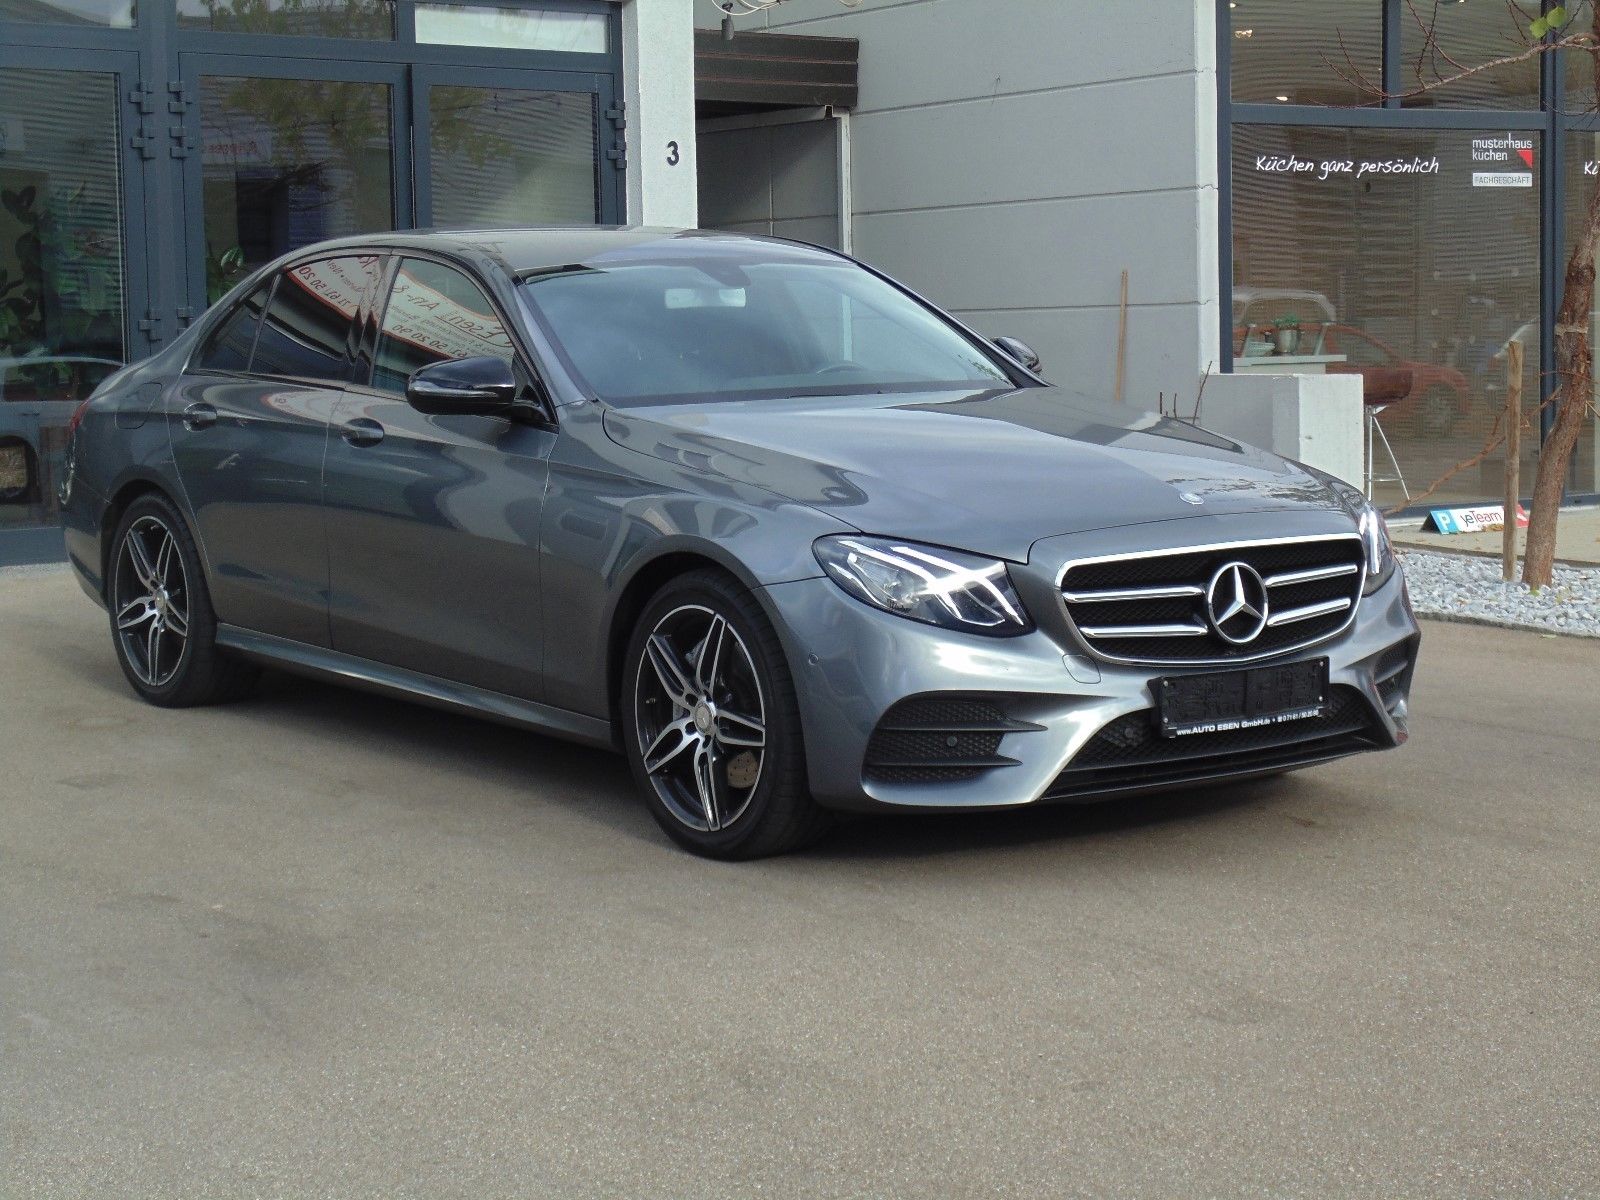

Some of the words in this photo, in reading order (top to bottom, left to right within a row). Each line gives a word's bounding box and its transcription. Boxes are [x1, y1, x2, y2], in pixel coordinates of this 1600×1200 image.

[1472, 133, 1532, 149] musterhaus
[666, 140, 680, 167] 3
[1472, 149, 1508, 161] küchen
[1256, 155, 1314, 173] Küchen
[1318, 160, 1354, 181] ganz
[1356, 156, 1439, 179] persönlich
[1437, 513, 1451, 531] P
[1217, 722, 1240, 731] ESEN
